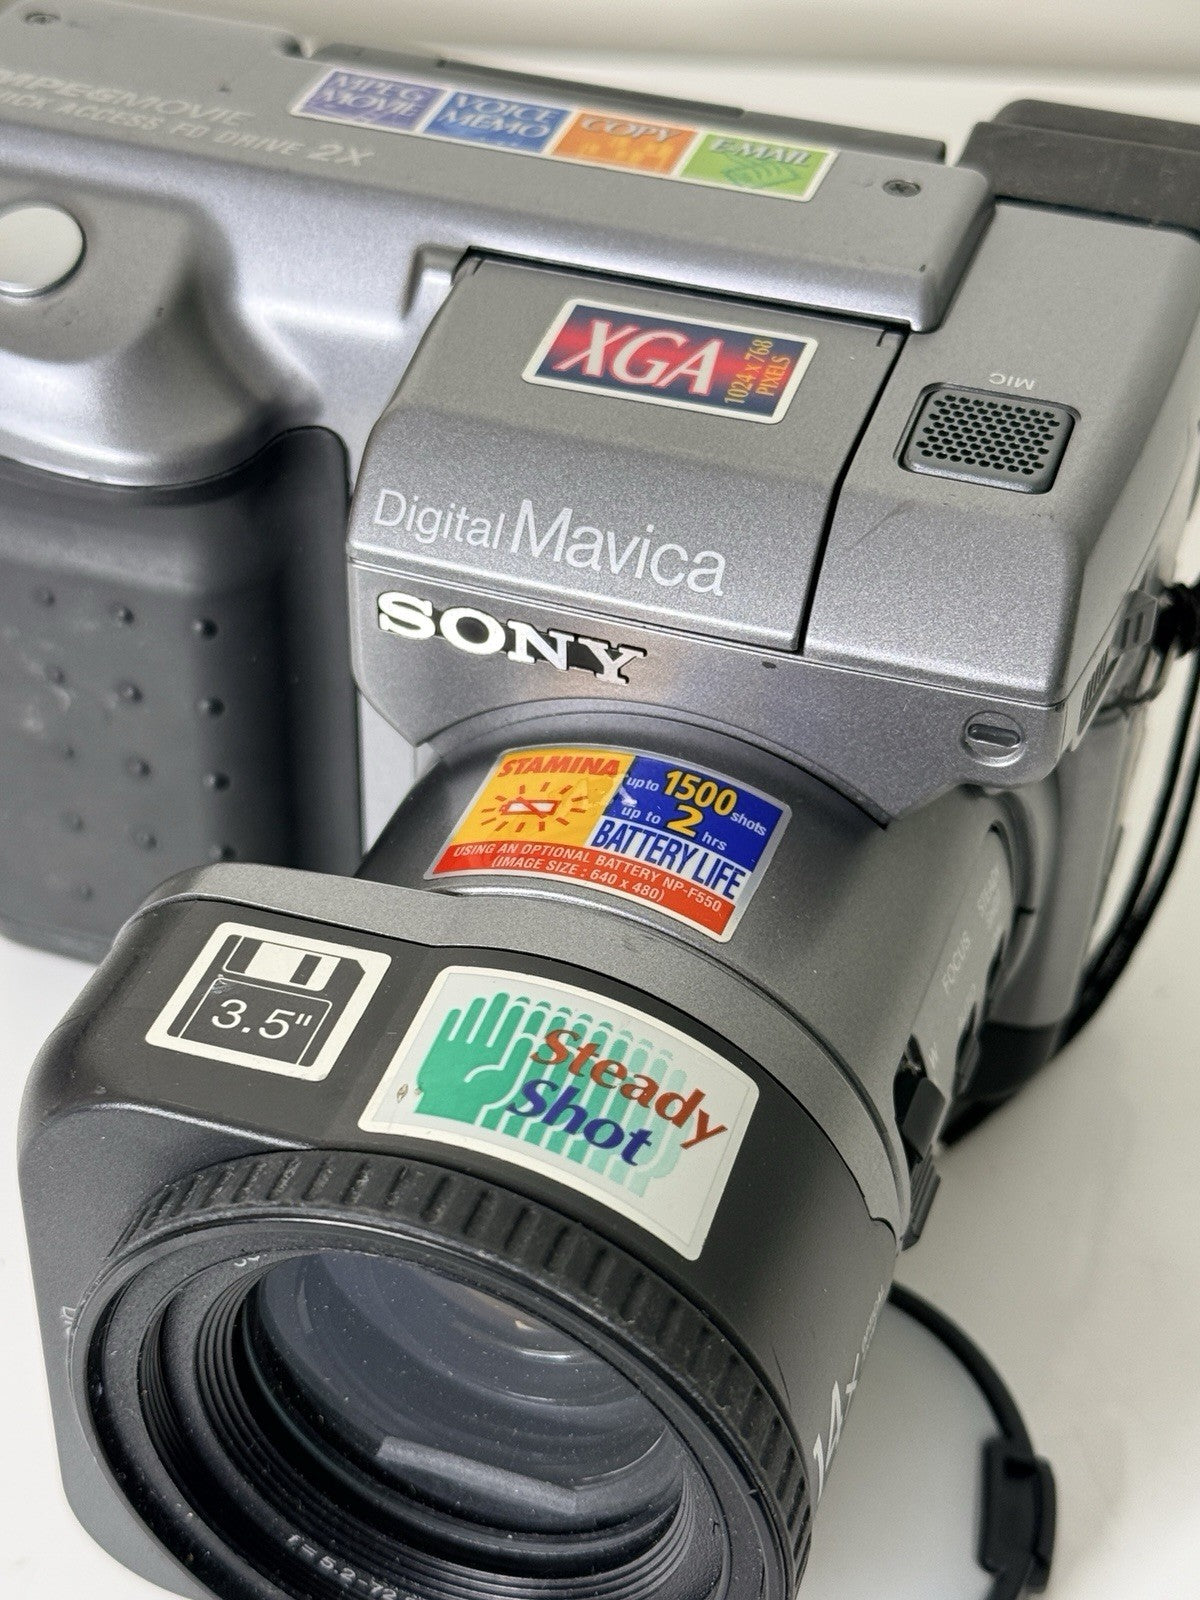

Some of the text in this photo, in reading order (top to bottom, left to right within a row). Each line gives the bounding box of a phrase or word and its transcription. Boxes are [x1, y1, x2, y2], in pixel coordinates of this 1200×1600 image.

[322, 87, 422, 118] MOVIE
[333, 74, 425, 101] MPEG
[455, 93, 558, 123] VOICE
[56, 102, 164, 130] ACCESS
[213, 130, 306, 156] DRIVE
[438, 109, 549, 139] MEMO
[581, 115, 683, 143] COPY
[553, 318, 724, 396] XGA
[724, 373, 756, 404] 1024
[744, 338, 774, 363] 768
[755, 354, 792, 398] PIXELS
[988, 372, 1036, 391] MIC
[374, 488, 727, 597] Digital Mavica
[377, 591, 648, 686] SONY
[498, 756, 620, 778] STAMINA
[664, 770, 739, 817] 1500
[730, 811, 768, 837] shots
[621, 804, 728, 852] up to 2 hrs
[453, 844, 723, 913] USING AN OPTIONAL BATTERY NP-F550
[491, 855, 546, 870] (IMAGE
[545, 860, 579, 876] SIZE
[589, 869, 618, 886] 640
[632, 882, 666, 903] 480)
[591, 820, 747, 900] BATTERY LIFE
[211, 998, 313, 1040] 3.5"
[530, 1028, 729, 1151] Steady
[505, 1078, 655, 1167] Shot
